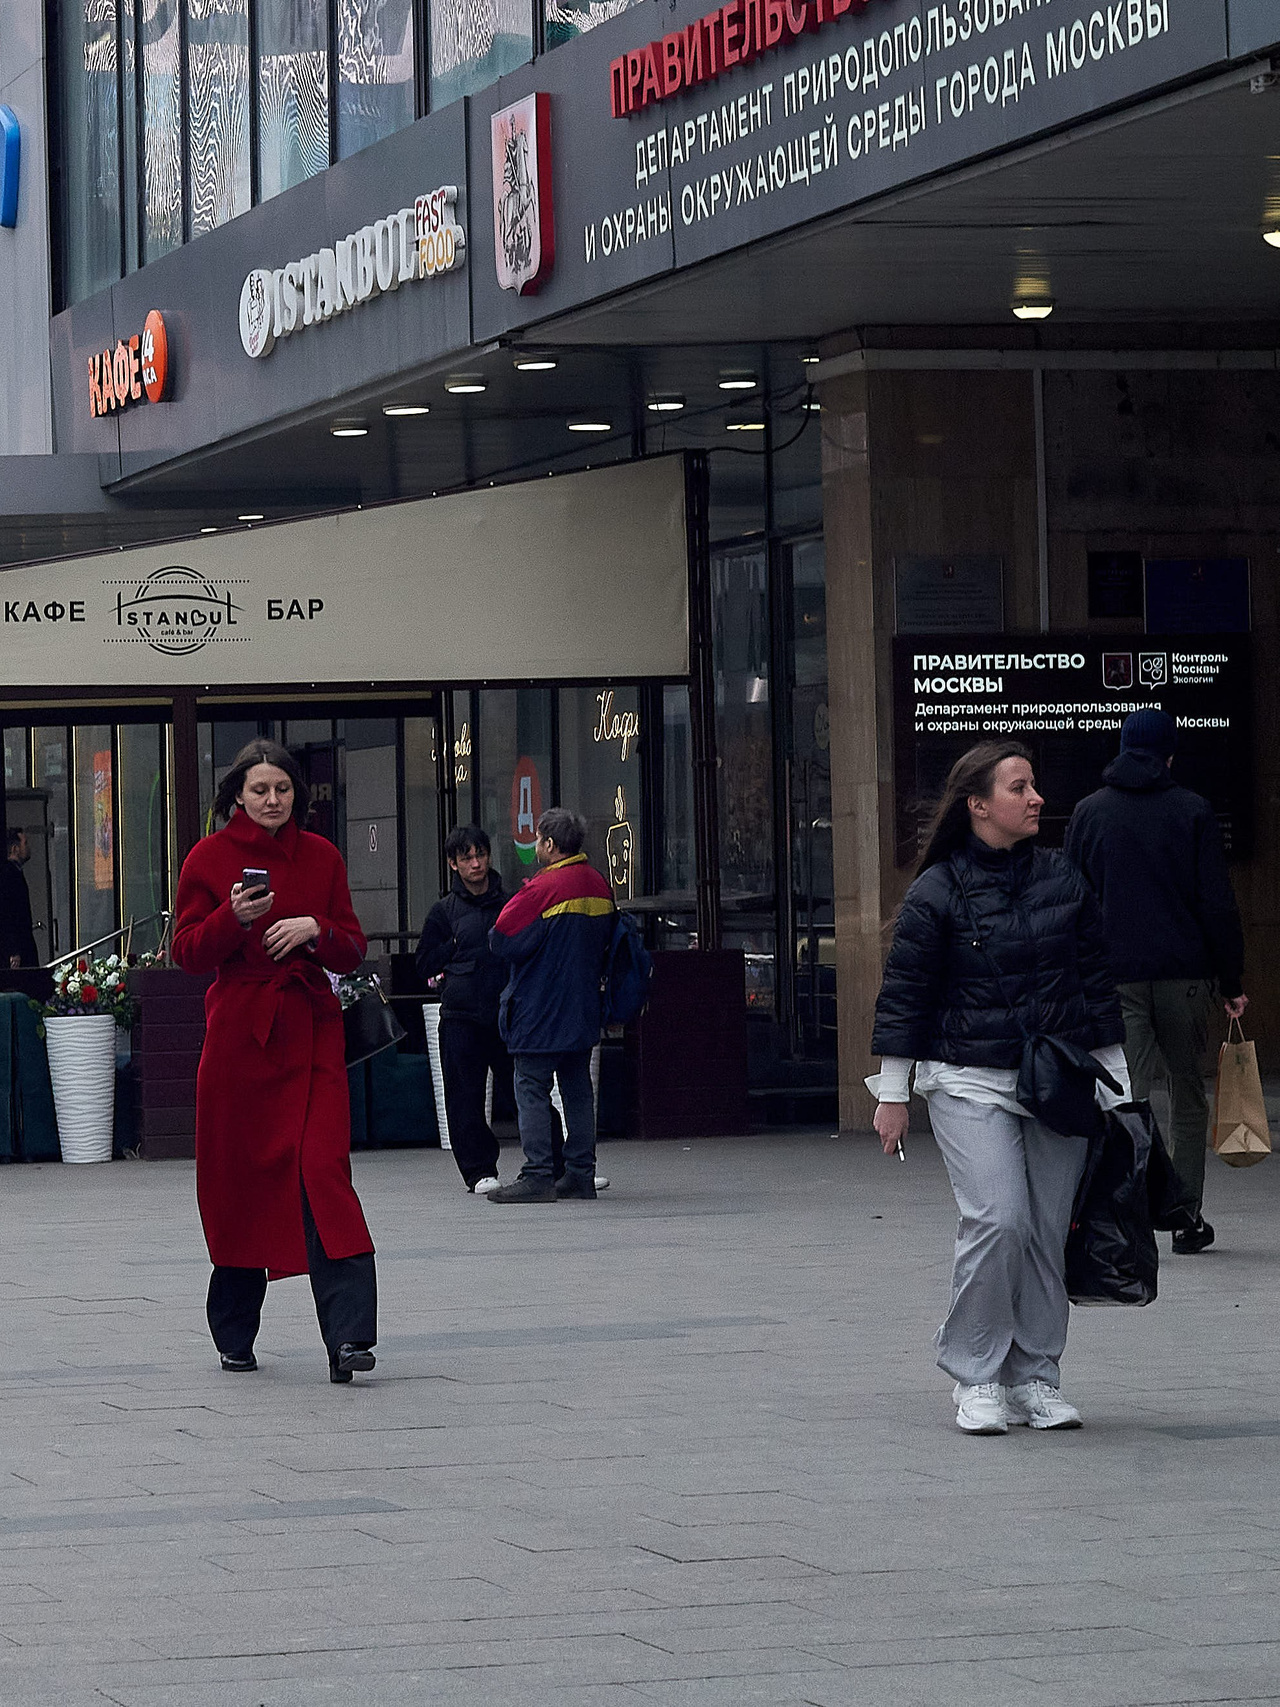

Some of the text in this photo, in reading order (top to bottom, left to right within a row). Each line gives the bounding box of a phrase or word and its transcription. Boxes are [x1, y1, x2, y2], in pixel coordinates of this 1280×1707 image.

[610, 0, 872, 119] ПРАВИТЕЛЬС
[635, 0, 1052, 189] ДЕПАРТАМЕНТ ПРИРОДОПОЛЬЗОВ
[584, 0, 1169, 263] И ОХРАНЫ ОКРУЖАЮЩЕЙ СРЕДЫ ГОРОДА МОСКВЫ
[415, 188, 447, 240] FAST
[420, 228, 456, 279] FOOD
[272, 208, 422, 339] ISTANBUL
[88, 333, 142, 419] КАФЕ
[4, 600, 86, 623] КАФЕ
[117, 591, 237, 627] ISTANBUL
[267, 599, 324, 621] БАР
[913, 653, 1086, 671] ПРАВИТЕЛЬСТВО
[1172, 652, 1229, 665] Контроль
[1172, 664, 1220, 675] Москвы
[914, 676, 1004, 694] МОСКВЫ
[1173, 675, 1214, 684] Экология
[915, 703, 1009, 718] Департамент
[915, 716, 1230, 734] и охраны окружающей среды Москвы
